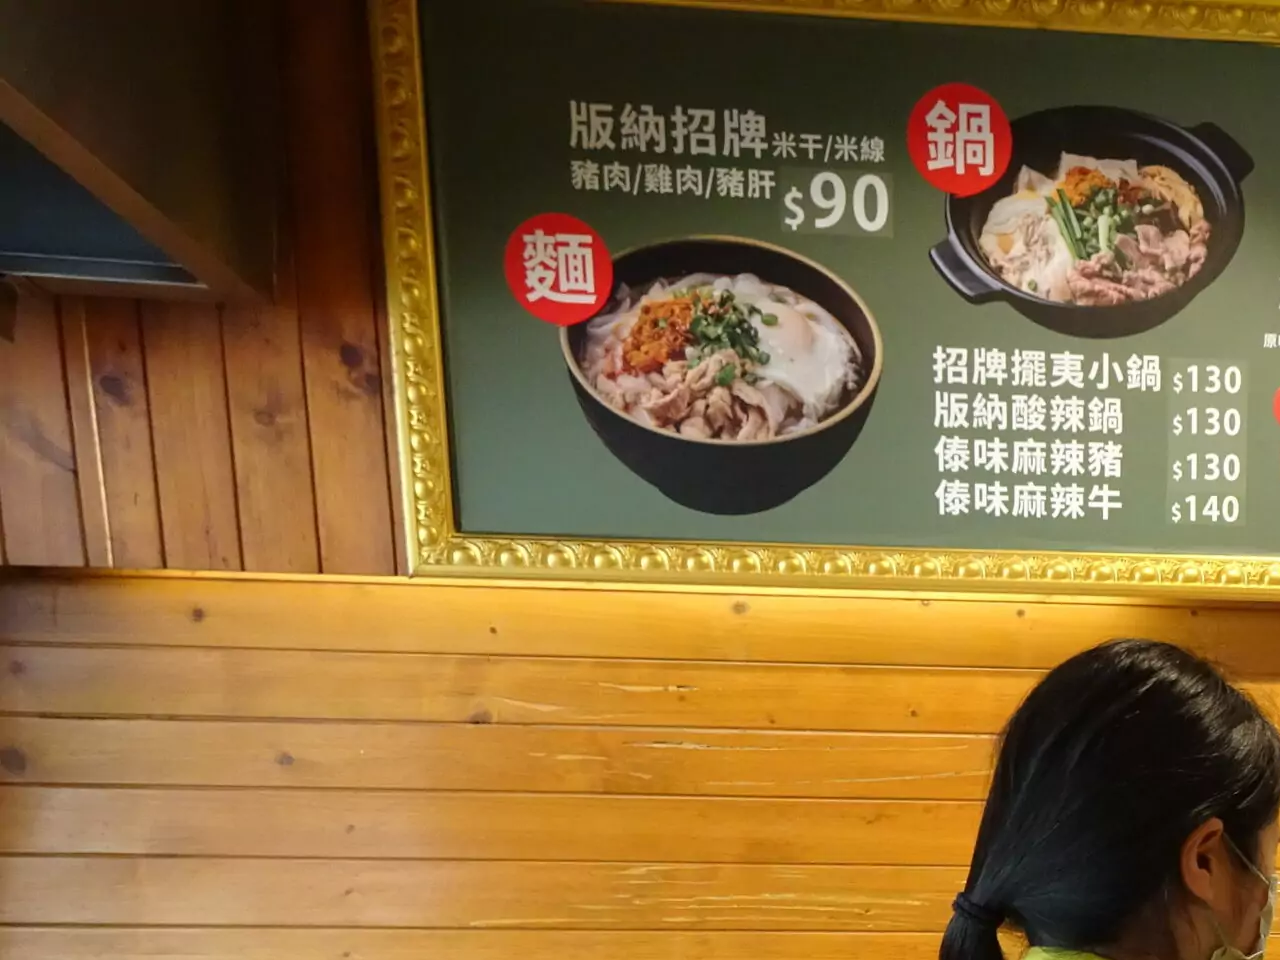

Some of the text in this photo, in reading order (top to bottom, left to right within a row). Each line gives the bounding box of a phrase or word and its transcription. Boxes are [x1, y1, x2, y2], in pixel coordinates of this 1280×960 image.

[569, 100, 885, 163] 版納招牌 米干/米線
[925, 100, 995, 177] 鍋
[570, 160, 776, 199] 豬肉/雞肉/豬肝
[784, 171, 889, 231] $90
[522, 229, 597, 305] 麵
[932, 346, 1242, 394] 招牌擺夷小鍋 $130
[934, 391, 1241, 437] 版納酸辣鍋 $130
[934, 435, 1241, 482] 傣味麻辣豬 $130
[934, 480, 1240, 523] 傣味麻辣牛 $140
